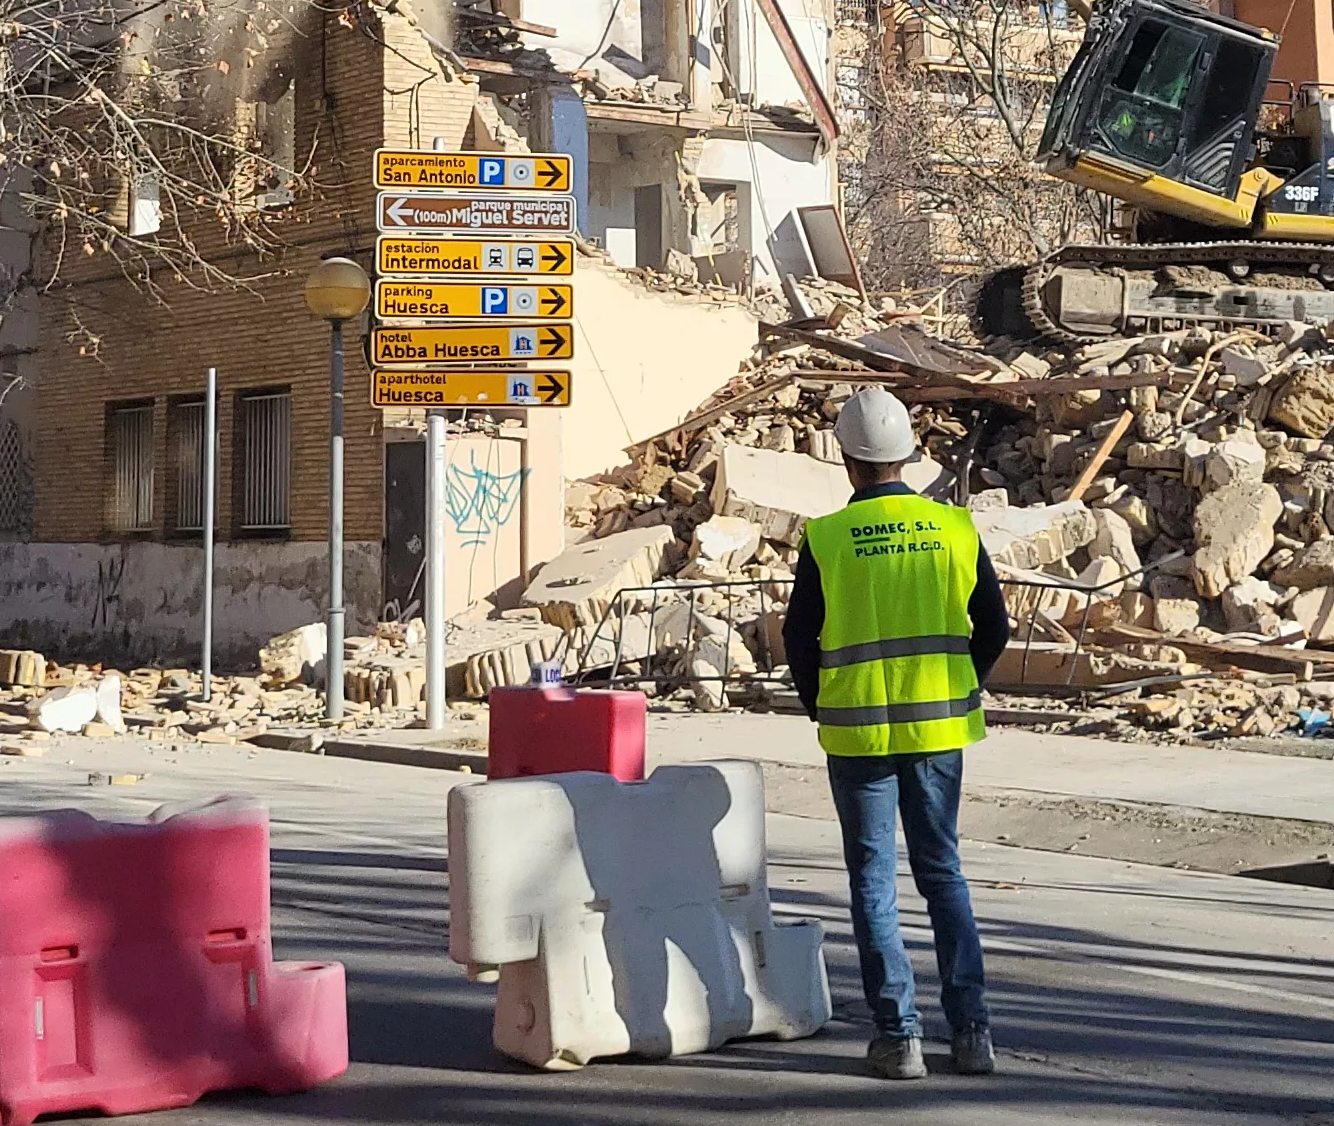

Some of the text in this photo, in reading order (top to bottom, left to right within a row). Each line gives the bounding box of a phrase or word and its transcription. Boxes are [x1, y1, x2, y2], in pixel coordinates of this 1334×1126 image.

[383, 157, 466, 168] aparcamiento
[383, 167, 476, 184] San Antonio
[483, 161, 501, 183] P
[1284, 185, 1320, 202] 336F
[471, 201, 568, 214] parque municipal
[414, 207, 568, 228] (100m) Miguel Servet
[385, 242, 440, 254] estación
[385, 253, 479, 270] intermodal
[384, 286, 433, 300] parking
[484, 289, 504, 312] P
[384, 299, 450, 314] Huesca
[380, 332, 413, 343] hotel
[381, 343, 501, 359] Abba Huesca
[379, 374, 447, 386] aparthotel
[379, 387, 444, 402] Huesca
[850, 521, 942, 538] DOMEC, S.L.
[854, 541, 945, 558] PLANTA R.C.D.
